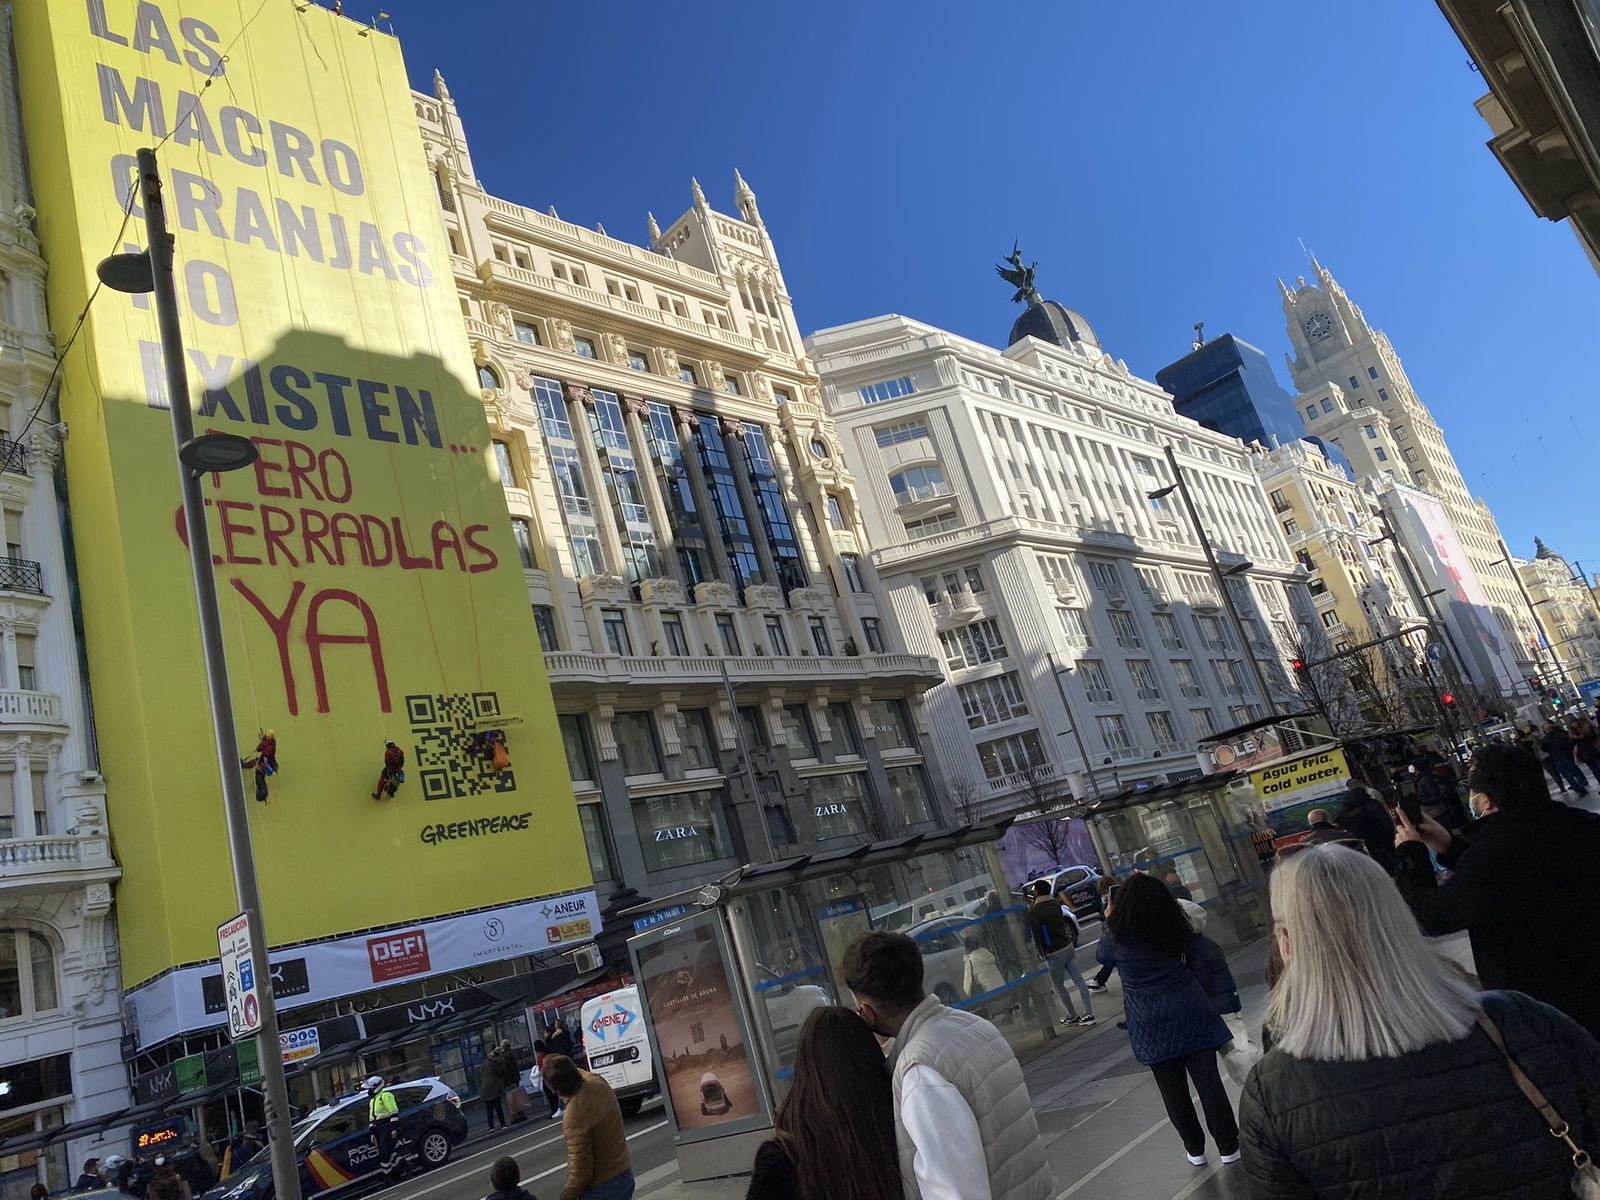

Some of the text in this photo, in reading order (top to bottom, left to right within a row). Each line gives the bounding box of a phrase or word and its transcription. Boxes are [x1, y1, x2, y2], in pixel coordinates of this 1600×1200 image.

[86, 0, 226, 77] LAS
[96, 62, 364, 197] MACRO
[229, 577, 393, 717] YA
[1262, 763, 1298, 782] Agua
[1296, 766, 1343, 785] water.
[814, 803, 848, 818] ZARA
[420, 811, 533, 846] GREENPEACE
[654, 826, 699, 842] ZARA
[554, 899, 586, 916] ANEUR
[561, 921, 591, 935] Lartec
[371, 935, 424, 962] DEFI
[407, 998, 455, 1024] NYX
[591, 1010, 629, 1033] GIMENEZ
[149, 1070, 173, 1096] NYX
